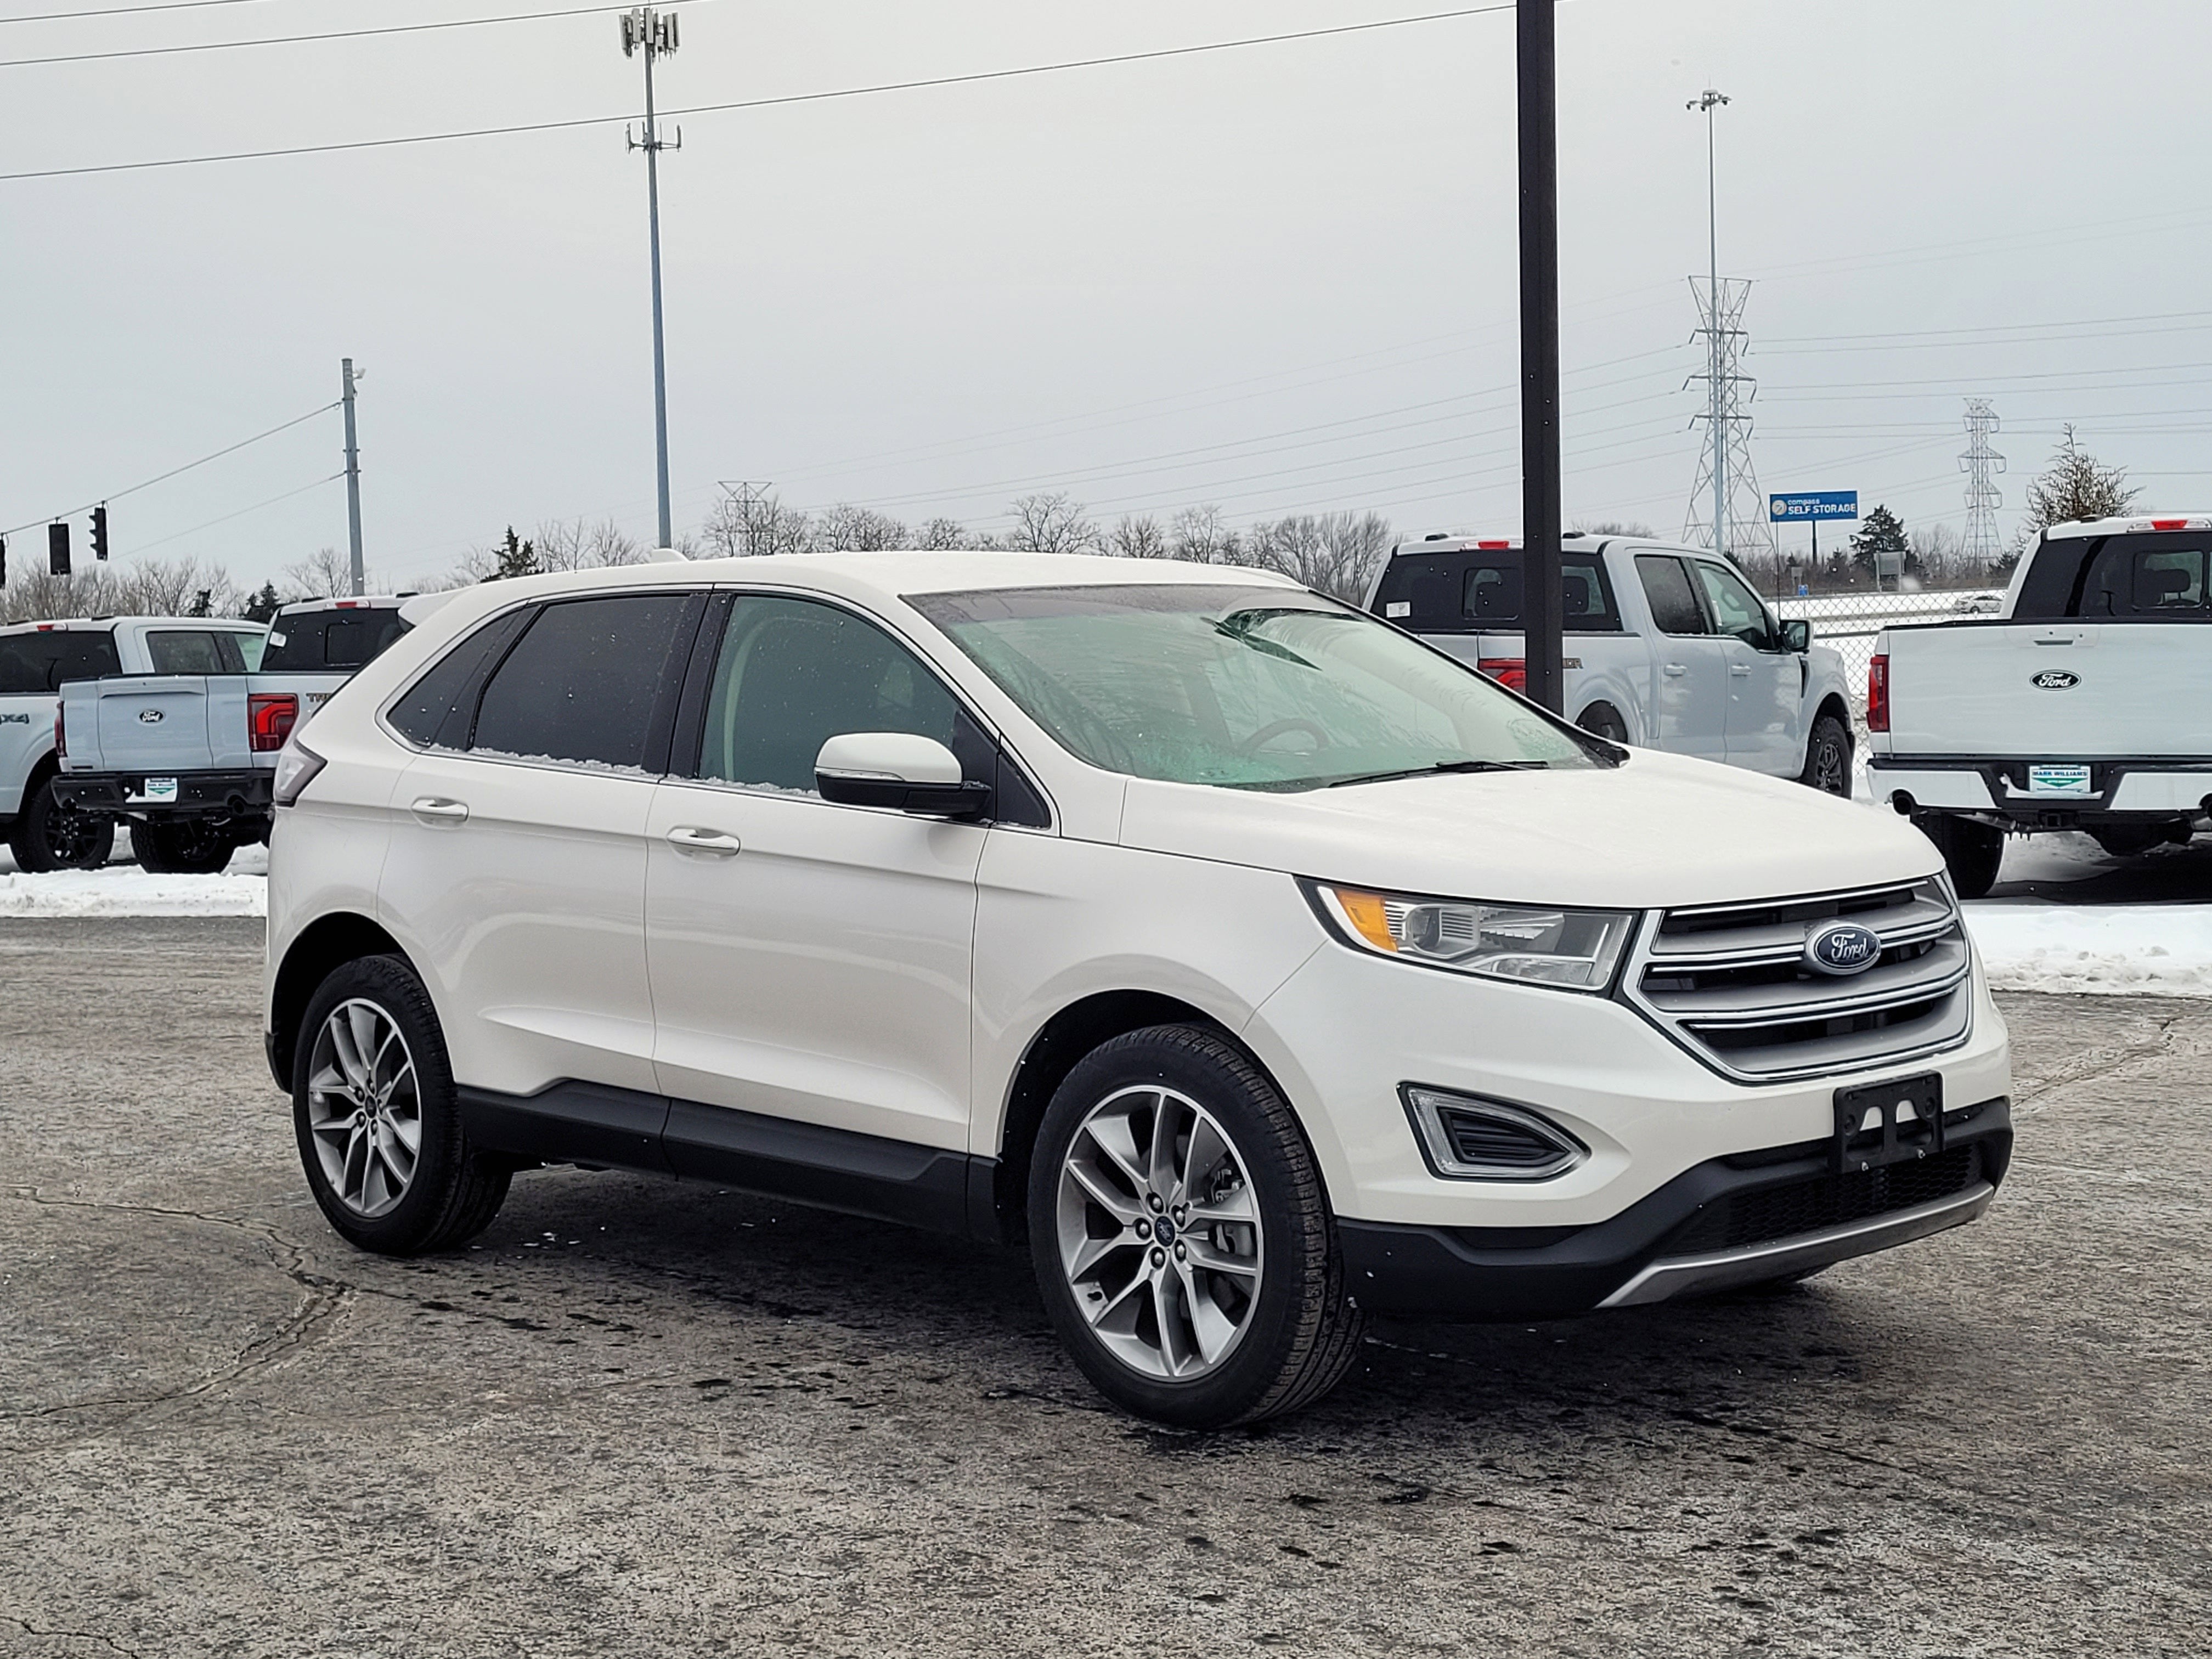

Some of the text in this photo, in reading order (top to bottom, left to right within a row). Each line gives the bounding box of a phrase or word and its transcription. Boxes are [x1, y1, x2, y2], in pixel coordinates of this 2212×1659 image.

[1787, 498, 1820, 506] compass
[1788, 504, 1857, 515] SELF STORAGE
[2039, 673, 2072, 687] Ford
[1831, 933, 1870, 962] Ford
